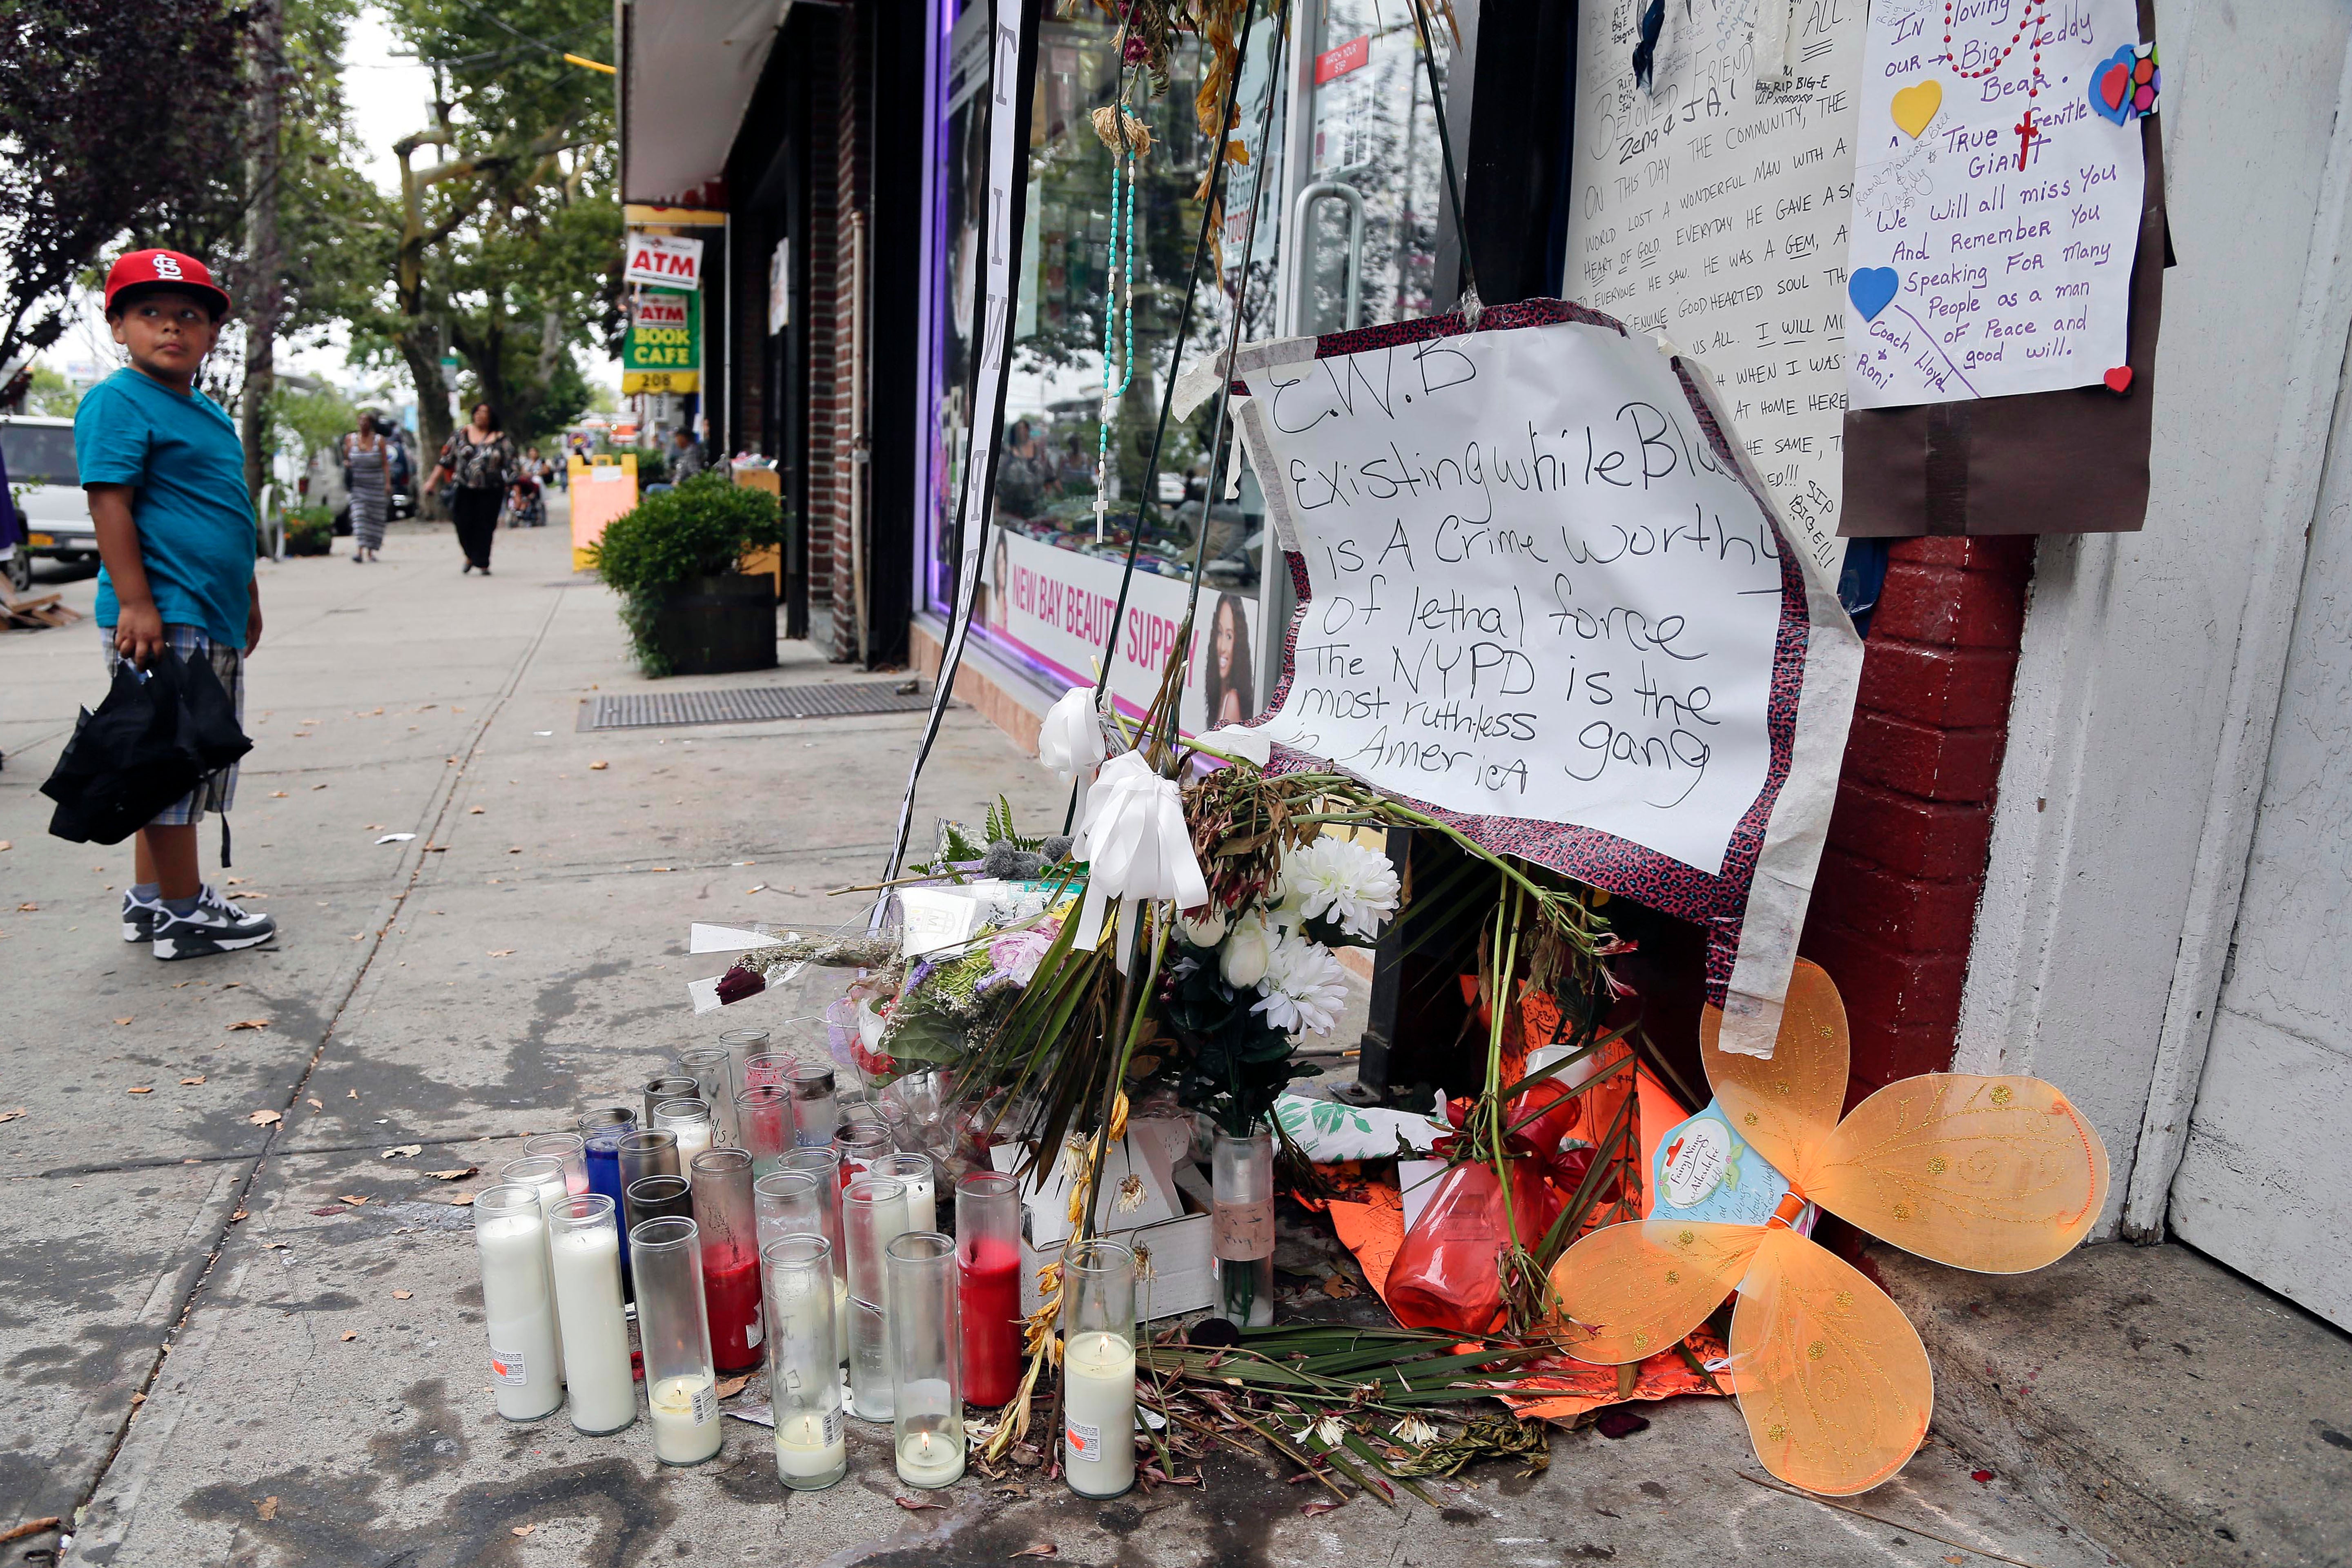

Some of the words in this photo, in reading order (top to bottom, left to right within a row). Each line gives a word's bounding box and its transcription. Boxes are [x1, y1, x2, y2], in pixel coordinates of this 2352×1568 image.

[2025, 13, 2094, 49] Teddy
[1584, 185, 1604, 220] ON
[1615, 176, 1639, 203] THIS
[1644, 157, 1670, 187] DAY
[1688, 134, 1712, 162] THE
[1726, 104, 1806, 149] COMMUNITY,
[1816, 90, 1848, 118] THE
[1586, 229, 1616, 253] WORLD
[1628, 209, 1653, 231] LOST
[1662, 201, 1670, 219] A
[1680, 176, 1746, 209] WONDERFUL
[1754, 160, 1781, 183] MAN
[1793, 147, 1823, 169] WITH
[1833, 137, 1847, 158] A
[1877, 209, 1907, 232] We
[1979, 183, 2005, 213] all
[2019, 180, 2070, 205] miss
[1584, 258, 1612, 281] HEART
[1620, 249, 1632, 264] OF
[1676, 216, 1733, 246] EVERYDAY
[1746, 205, 1763, 229] HE
[1776, 194, 1811, 220] GAVE
[1823, 186, 1834, 206] A
[1891, 232, 1929, 263] And
[632, 249, 694, 277] ATM
[1595, 287, 1635, 308] EVERYONE
[1648, 276, 1661, 292] HE
[1704, 256, 1718, 276] HE
[1729, 250, 1753, 267] WAS
[1764, 239, 1775, 261] A
[1833, 225, 1848, 245] A
[1904, 263, 1987, 296] Speaking
[1777, 275, 1809, 294] SOUL
[640, 306, 684, 321] ATM
[1929, 290, 1980, 323] People
[1998, 294, 2018, 307] as
[2029, 289, 2042, 301] a
[1984, 319, 2037, 339] Peace
[2054, 305, 2087, 331] and
[633, 328, 690, 345] BOOK
[1693, 340, 1706, 354] US
[1756, 322, 1769, 340] I
[1782, 318, 1814, 334] WILL
[1869, 320, 1911, 354] Coach
[633, 347, 689, 364] CAFE
[1736, 363, 1777, 384] WHEN
[1786, 360, 1801, 375] I
[1963, 341, 2004, 370] good
[641, 374, 671, 388] 208
[1734, 400, 1751, 421] AT
[1761, 398, 1798, 416] HOME
[1318, 536, 1364, 579] is
[1382, 518, 1415, 571] A
[1013, 564, 1036, 613] NEW
[1039, 577, 1064, 626] BAY
[1127, 607, 1200, 688] SUPPY
[1409, 584, 1525, 646] lethal
[1549, 573, 1709, 661] force
[1296, 644, 1365, 678] The
[1392, 639, 1535, 699] NYPD
[1566, 657, 1614, 707] is
[1634, 661, 1720, 726] the
[1298, 686, 1389, 719] most
[1566, 719, 1711, 809] gang
